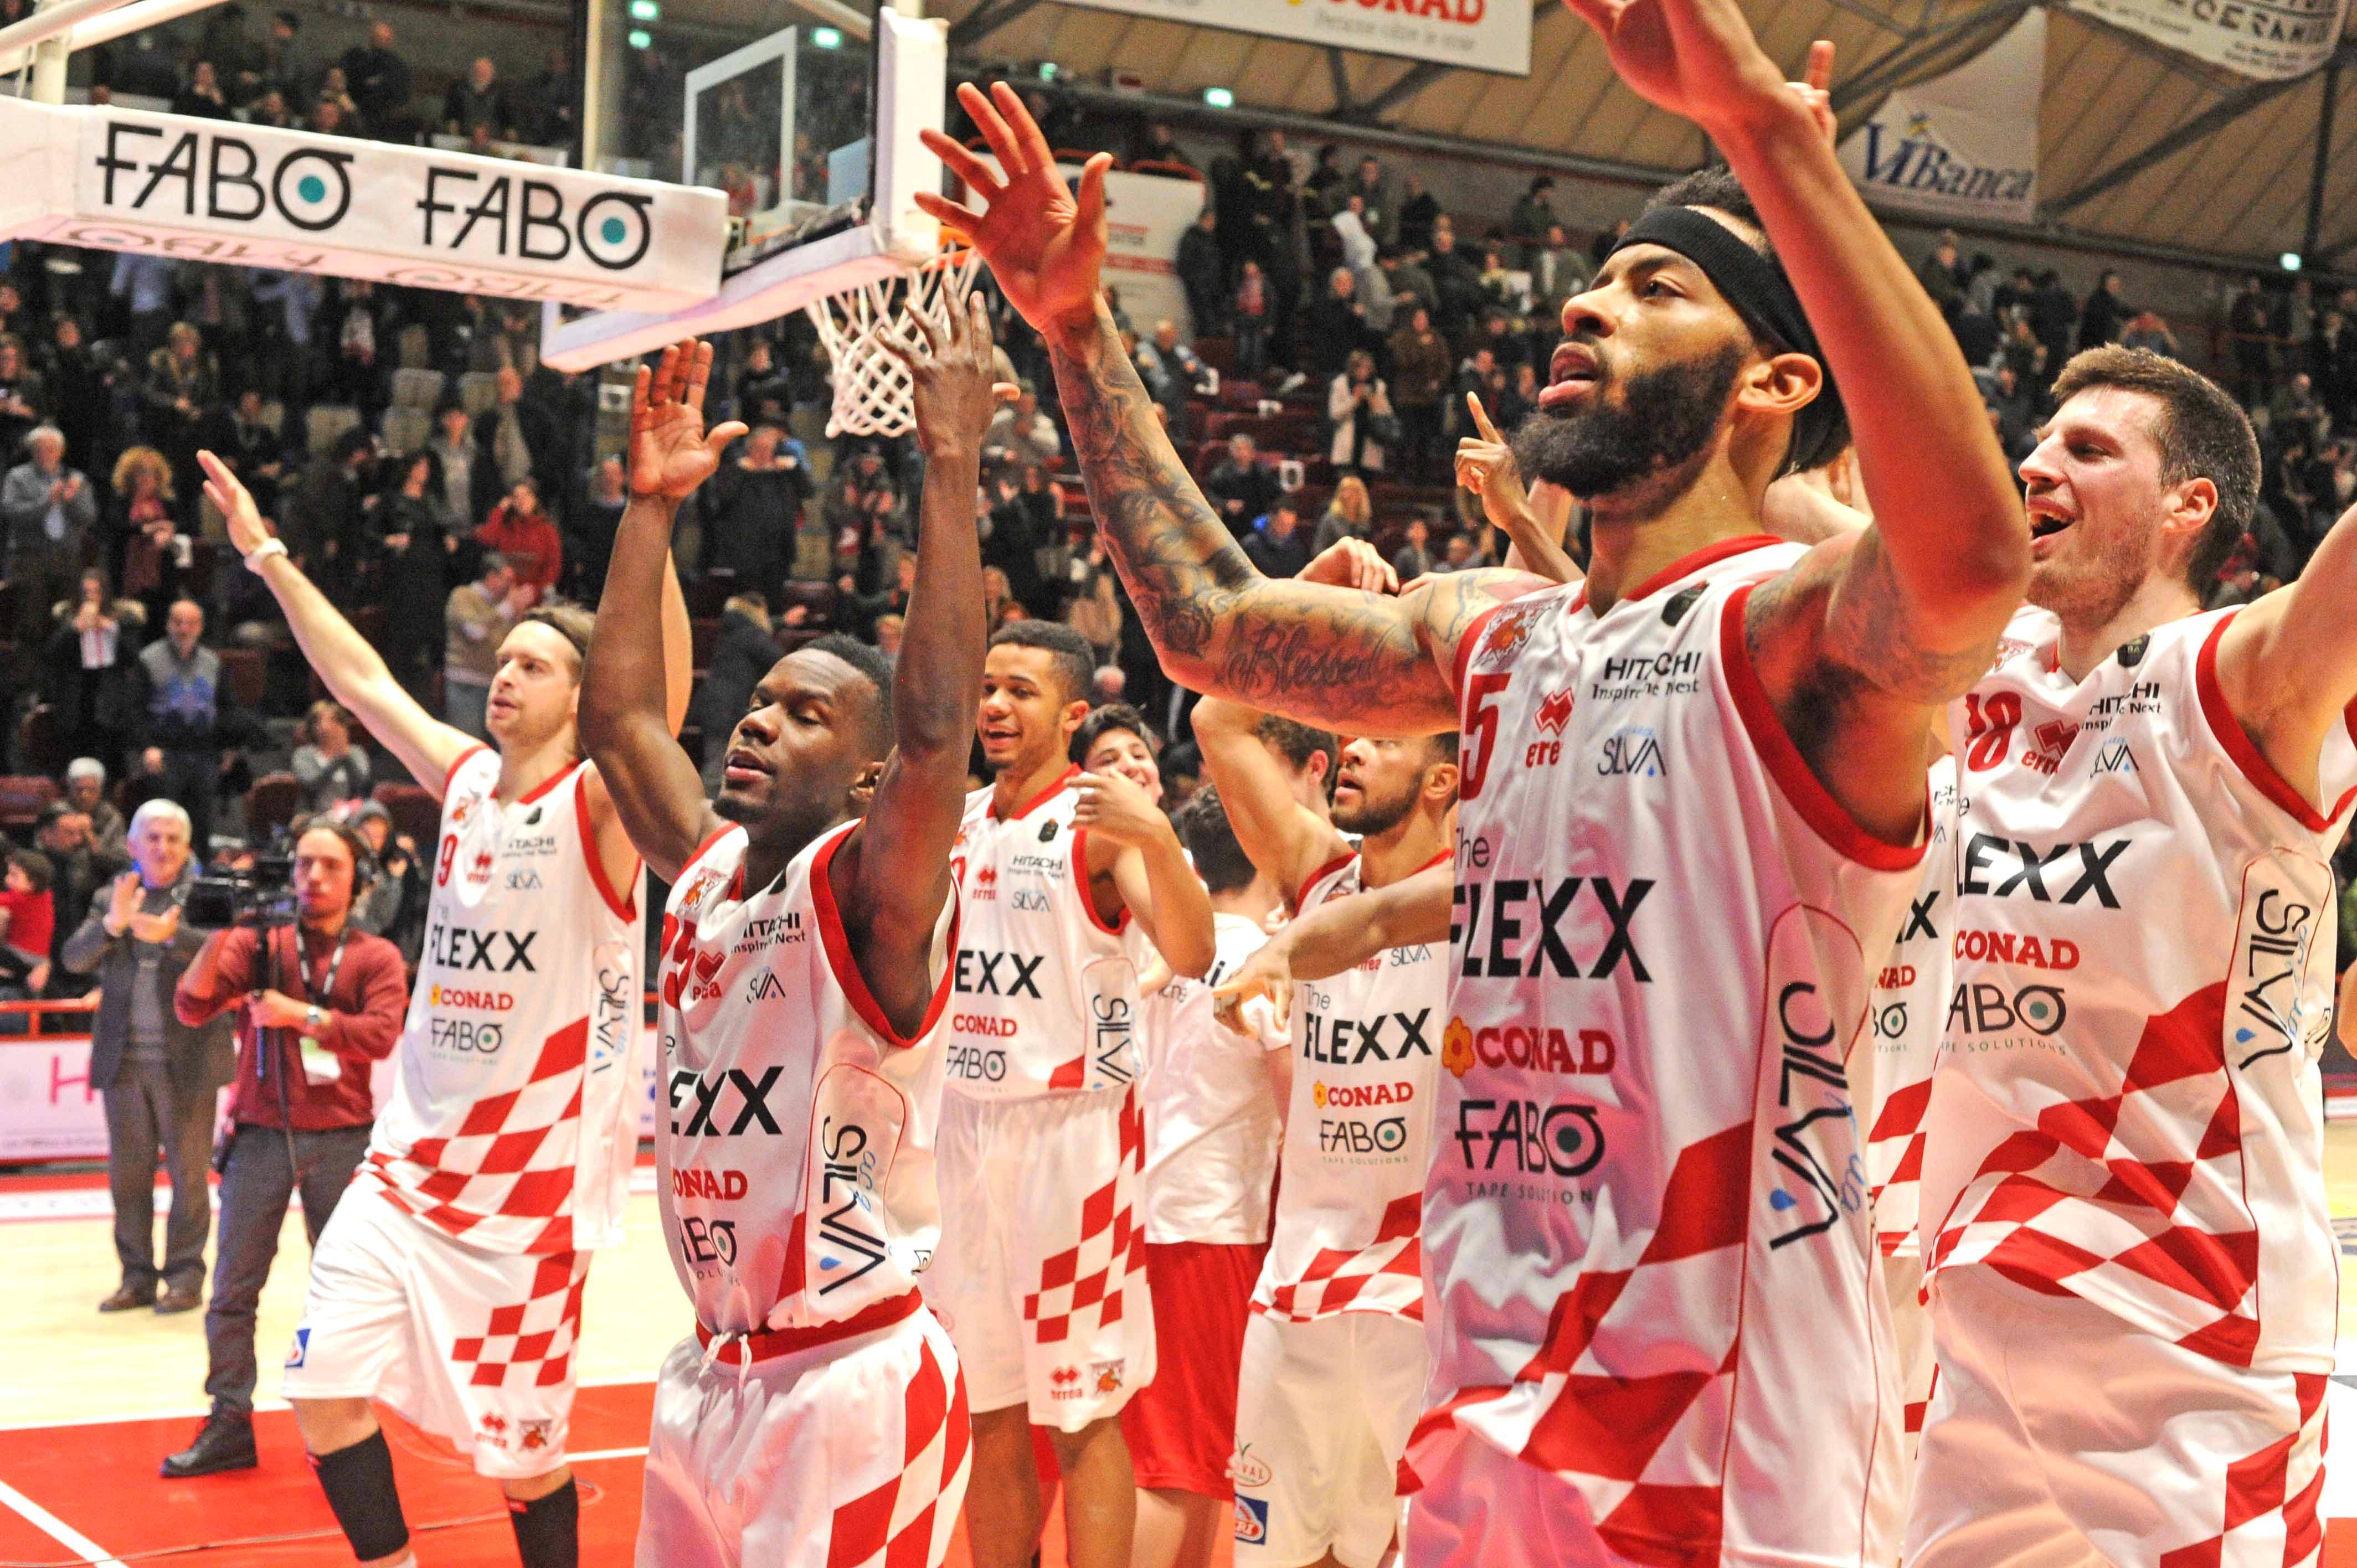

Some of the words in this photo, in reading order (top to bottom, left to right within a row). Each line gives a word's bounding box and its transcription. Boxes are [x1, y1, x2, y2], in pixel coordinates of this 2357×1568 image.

[96, 121, 353, 231] FABO
[416, 167, 653, 270] FABO
[1604, 652, 1701, 680] HITCHI
[438, 834, 457, 887] 9
[1456, 828, 1490, 869] he
[1956, 829, 2132, 910] LEXX
[775, 930, 806, 944] Next
[1955, 930, 2080, 970] CONAD
[440, 986, 513, 1010] CONAD
[955, 950, 1044, 999] EXX
[1304, 984, 1331, 1010] The
[2238, 889, 2311, 1071] SILVA
[953, 1014, 1017, 1037] CONAD
[1945, 983, 2067, 1036] ABO
[431, 1017, 502, 1054] FABO
[1304, 1008, 1433, 1065] FLEXX
[1475, 1026, 1617, 1075] CONAD
[670, 1066, 785, 1137] EXX
[1328, 1081, 1414, 1107] CONAD
[1769, 982, 1853, 1251] SILVA
[1320, 1116, 1406, 1153] FABO
[1454, 1099, 1605, 1178] FABO
[672, 1169, 748, 1201] ONAD
[819, 1115, 886, 1296] SILVA
